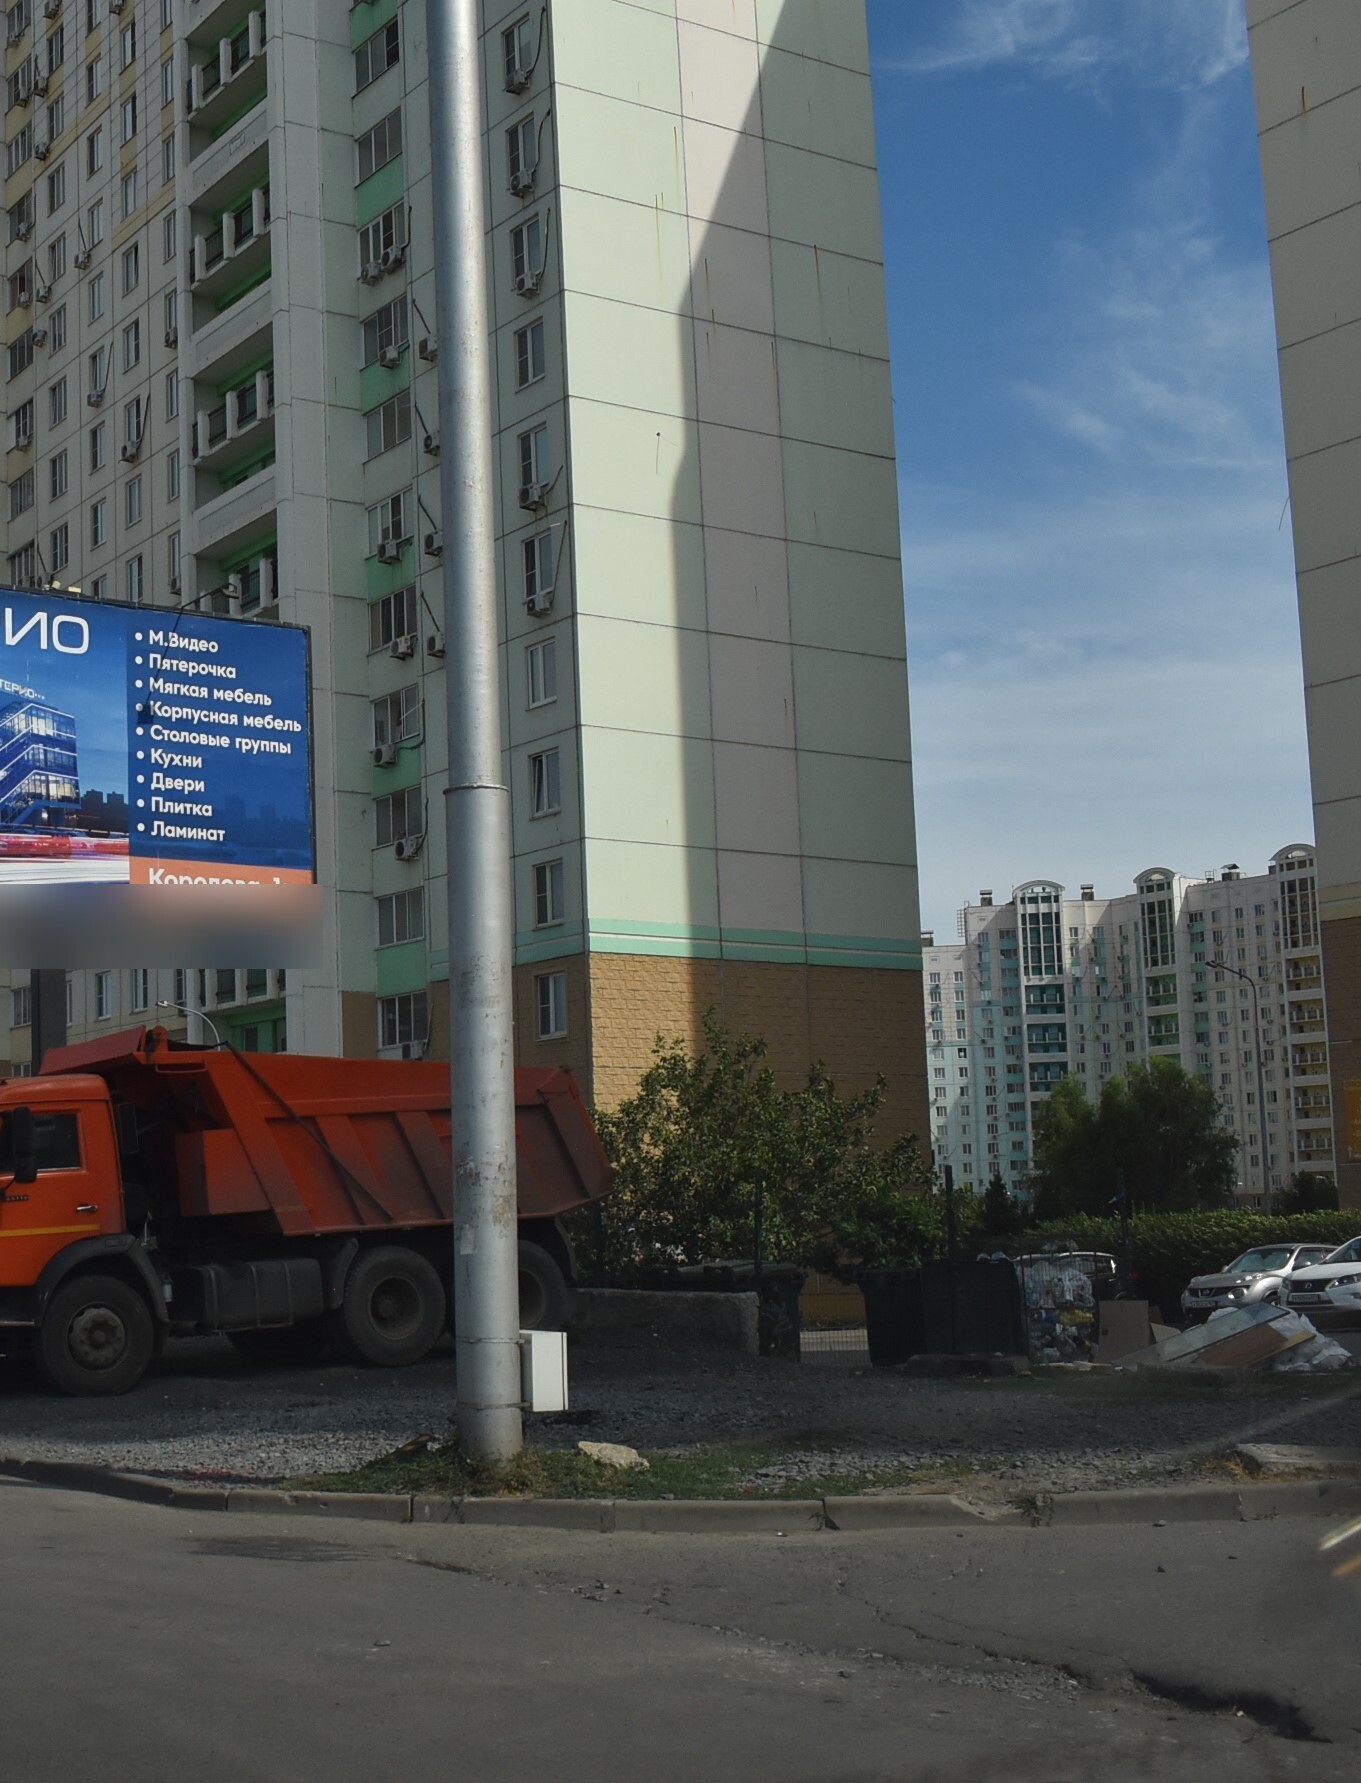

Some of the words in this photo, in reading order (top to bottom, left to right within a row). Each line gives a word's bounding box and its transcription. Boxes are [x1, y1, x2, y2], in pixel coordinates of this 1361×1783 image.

[149, 629, 219, 653] М.Видео
[149, 653, 237, 679] Пятерочка
[149, 677, 209, 699] Мягкая
[213, 688, 273, 706] мебель
[149, 700, 239, 725] Корпусная
[243, 715, 302, 732] мебель
[150, 724, 231, 747] Столовые
[235, 738, 292, 755] группы
[150, 749, 203, 769] Кухни
[150, 773, 205, 795] Двери
[151, 797, 213, 817] Плитка
[151, 821, 226, 842] Ламинат
